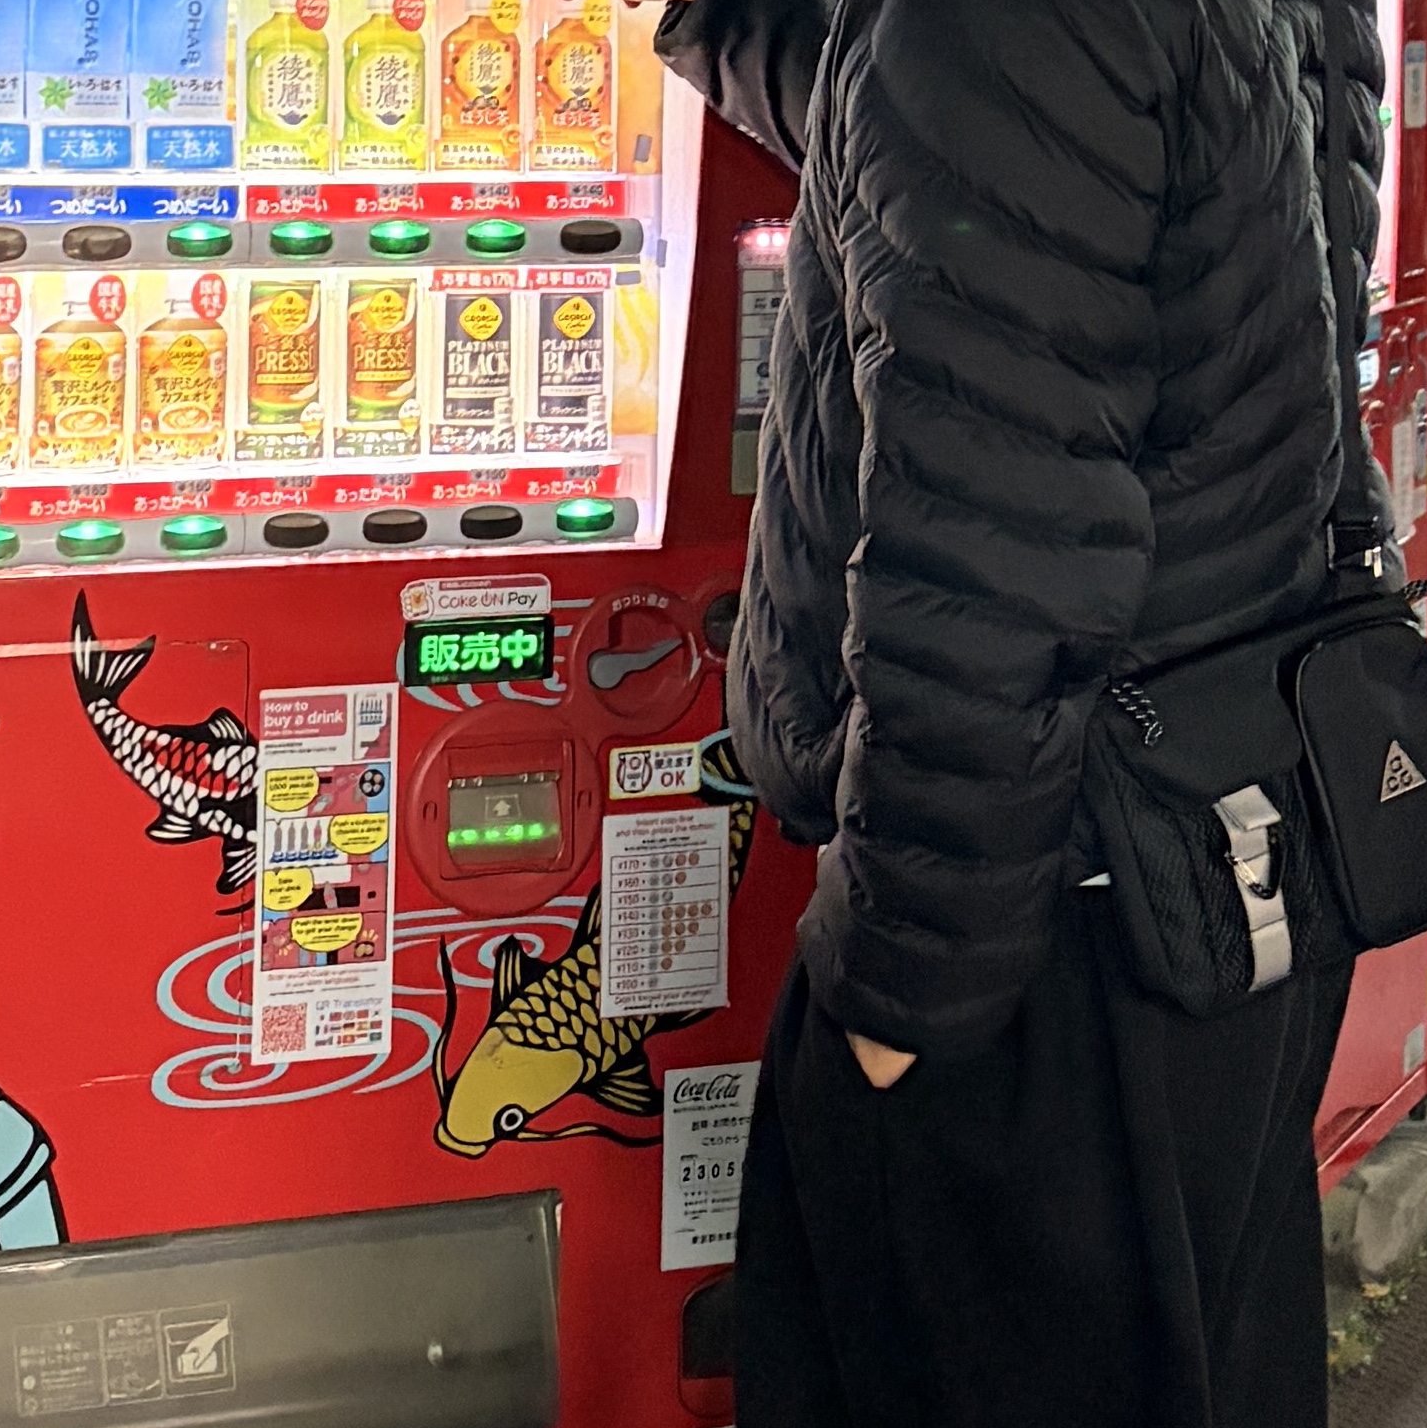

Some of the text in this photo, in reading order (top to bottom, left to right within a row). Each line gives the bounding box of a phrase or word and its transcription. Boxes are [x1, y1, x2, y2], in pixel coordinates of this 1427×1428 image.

[276, 54, 305, 110] 綾鷹
[375, 54, 403, 110] 綾鷹
[459, 110, 509, 125] ほうじ茶
[553, 110, 601, 126] ほうじ茶
[60, 140, 118, 159] 天然水
[163, 140, 220, 158] 天然水
[447, 351, 510, 377] BLACK
[542, 350, 603, 375] BLACK
[57, 393, 111, 407] カフェオレ
[159, 390, 212, 404] カフェオレ
[438, 594, 479, 610] Coke
[506, 591, 539, 610] Pay
[420, 629, 539, 672] 販売中
[264, 701, 308, 713] How to
[264, 709, 344, 729] buy a drink
[660, 771, 686, 788] OK
